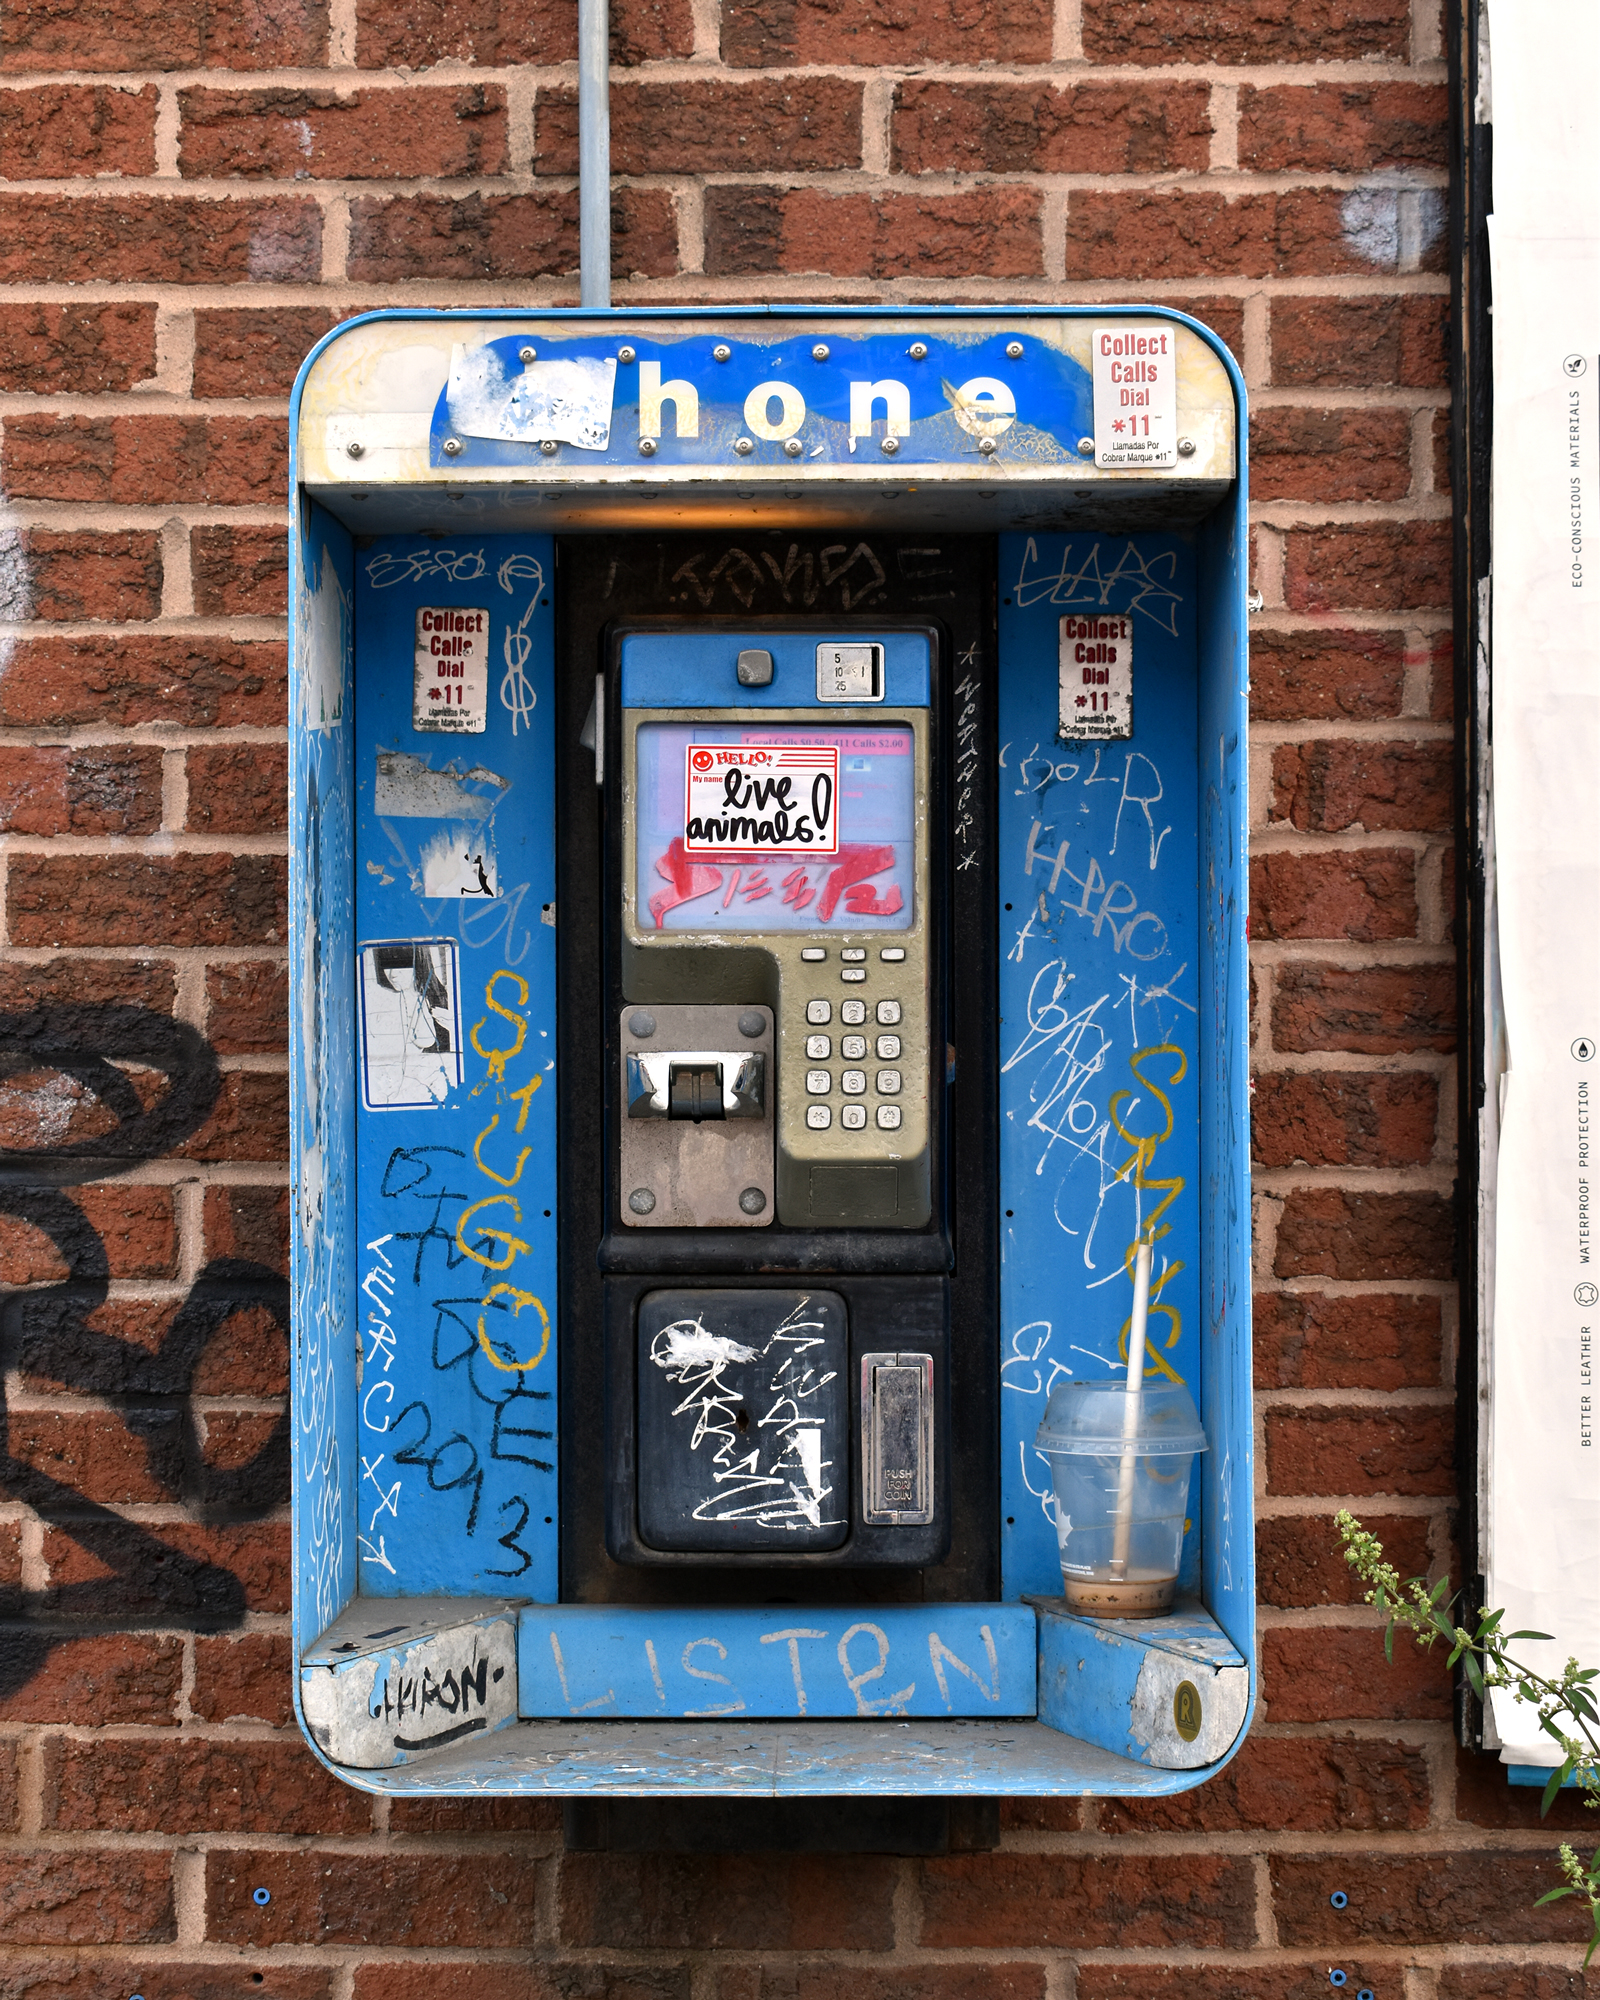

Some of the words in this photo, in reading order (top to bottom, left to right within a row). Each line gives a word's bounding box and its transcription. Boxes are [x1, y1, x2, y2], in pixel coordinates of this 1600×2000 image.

[1100, 333, 1168, 356] Collect
[1110, 360, 1158, 383] Calls
[638, 361, 1017, 441] hone
[1120, 387, 1150, 406] Dial
[1569, 390, 1580, 468] MATERIALS
[1112, 440, 1146, 451] Llamadas
[1147, 440, 1160, 450] Por
[1101, 452, 1126, 462] Cobrar
[1127, 452, 1154, 463] Marque
[1570, 477, 1582, 588] ECO-CONSCIOUS
[422, 611, 483, 633] Collect
[1066, 618, 1127, 639] Collect
[430, 635, 473, 657] Calls
[1074, 642, 1117, 664] Calls
[834, 653, 841, 664] 5
[437, 660, 464, 678] Dial
[834, 666, 844, 678] 10
[1082, 667, 1110, 685] Dial
[834, 680, 847, 692] 25
[774, 737, 798, 745] Calls
[800, 738, 825, 746] $050
[833, 738, 849, 748] 411
[852, 738, 876, 748] Calls
[879, 738, 903, 748] $2.00
[715, 751, 773, 767] HELLO!
[692, 775, 702, 784] My
[722, 767, 798, 811] live
[815, 1008, 823, 1020] 1
[849, 1009, 859, 1021] 2
[884, 1009, 894, 1021] 3
[813, 1043, 824, 1055] 4
[849, 1043, 859, 1055] 5
[884, 1043, 894, 1055] 6
[814, 1078, 824, 1090] 7
[849, 1078, 859, 1090] 8
[884, 1078, 894, 1090] 9
[849, 1112, 859, 1124] 0
[1578, 1081, 1589, 1167] PROTECTION
[1579, 1177, 1590, 1264] WATERPROOF
[1580, 1325, 1591, 1386] LEATHER
[1581, 1395, 1591, 1447] BETTER
[884, 1469, 913, 1478] PUSH
[887, 1480, 911, 1489] FOR
[884, 1491, 913, 1500] COIN
